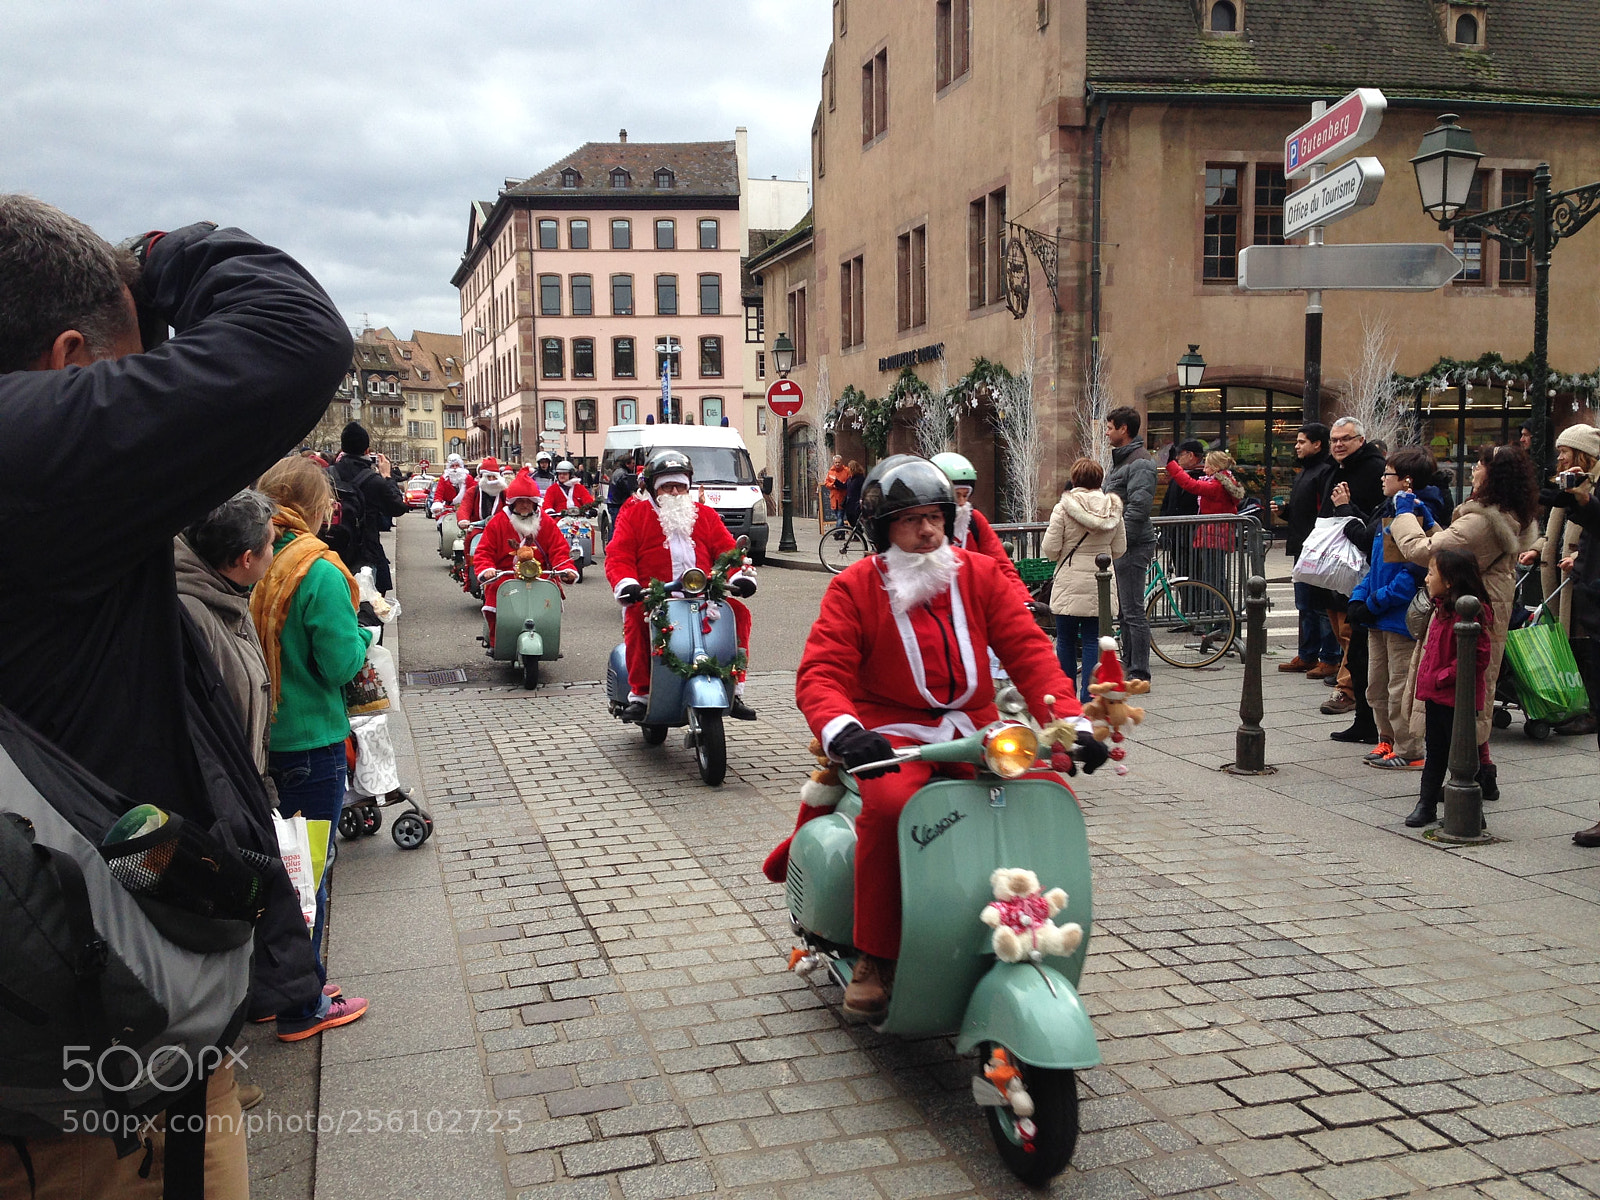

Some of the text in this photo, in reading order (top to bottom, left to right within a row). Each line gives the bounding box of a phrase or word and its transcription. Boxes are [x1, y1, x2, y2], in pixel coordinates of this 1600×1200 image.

[1290, 113, 1351, 168] P Gutenberg
[1287, 176, 1356, 225] Office du Tourisme
[887, 349, 918, 369] NOUVELLE
[1557, 671, 1584, 688] 100
[911, 809, 968, 851] Vespa
